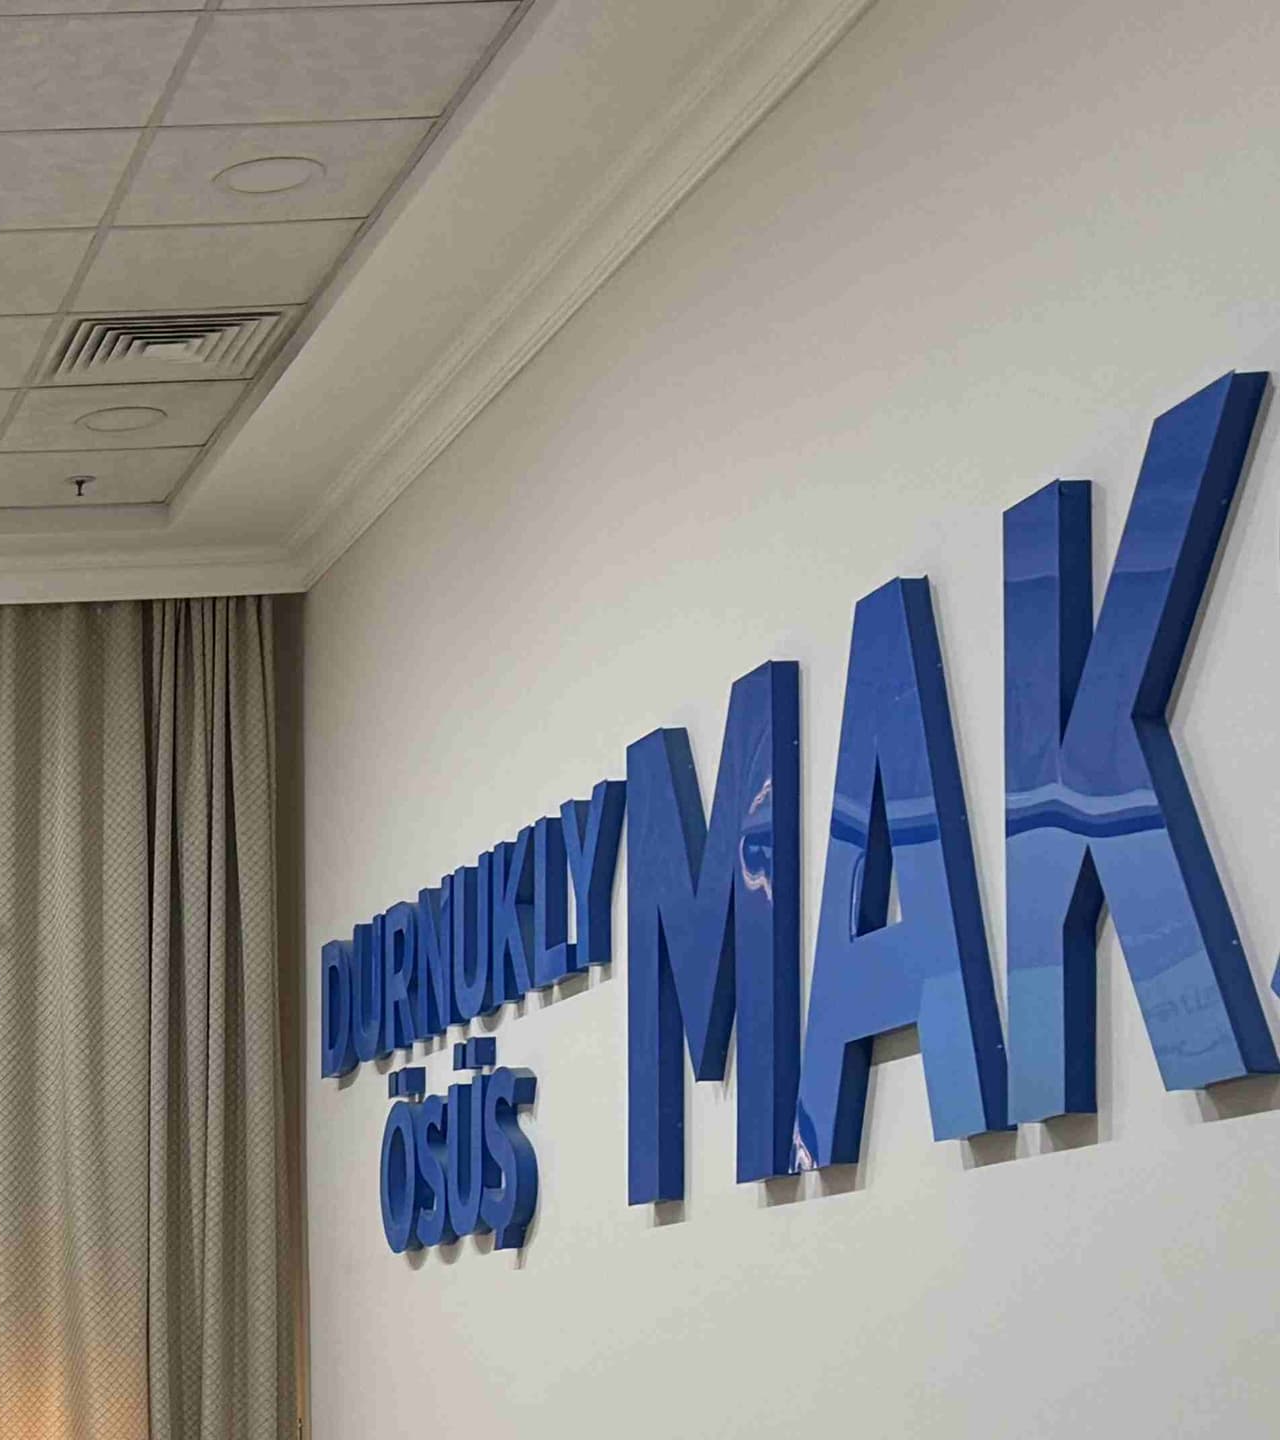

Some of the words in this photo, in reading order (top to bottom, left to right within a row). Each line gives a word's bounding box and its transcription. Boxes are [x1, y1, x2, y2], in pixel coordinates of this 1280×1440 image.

[321, 779, 627, 1078] DURNUKLY
[627, 370, 1280, 1206] MAK
[380, 1036, 537, 1253] ÖSÜŞ
